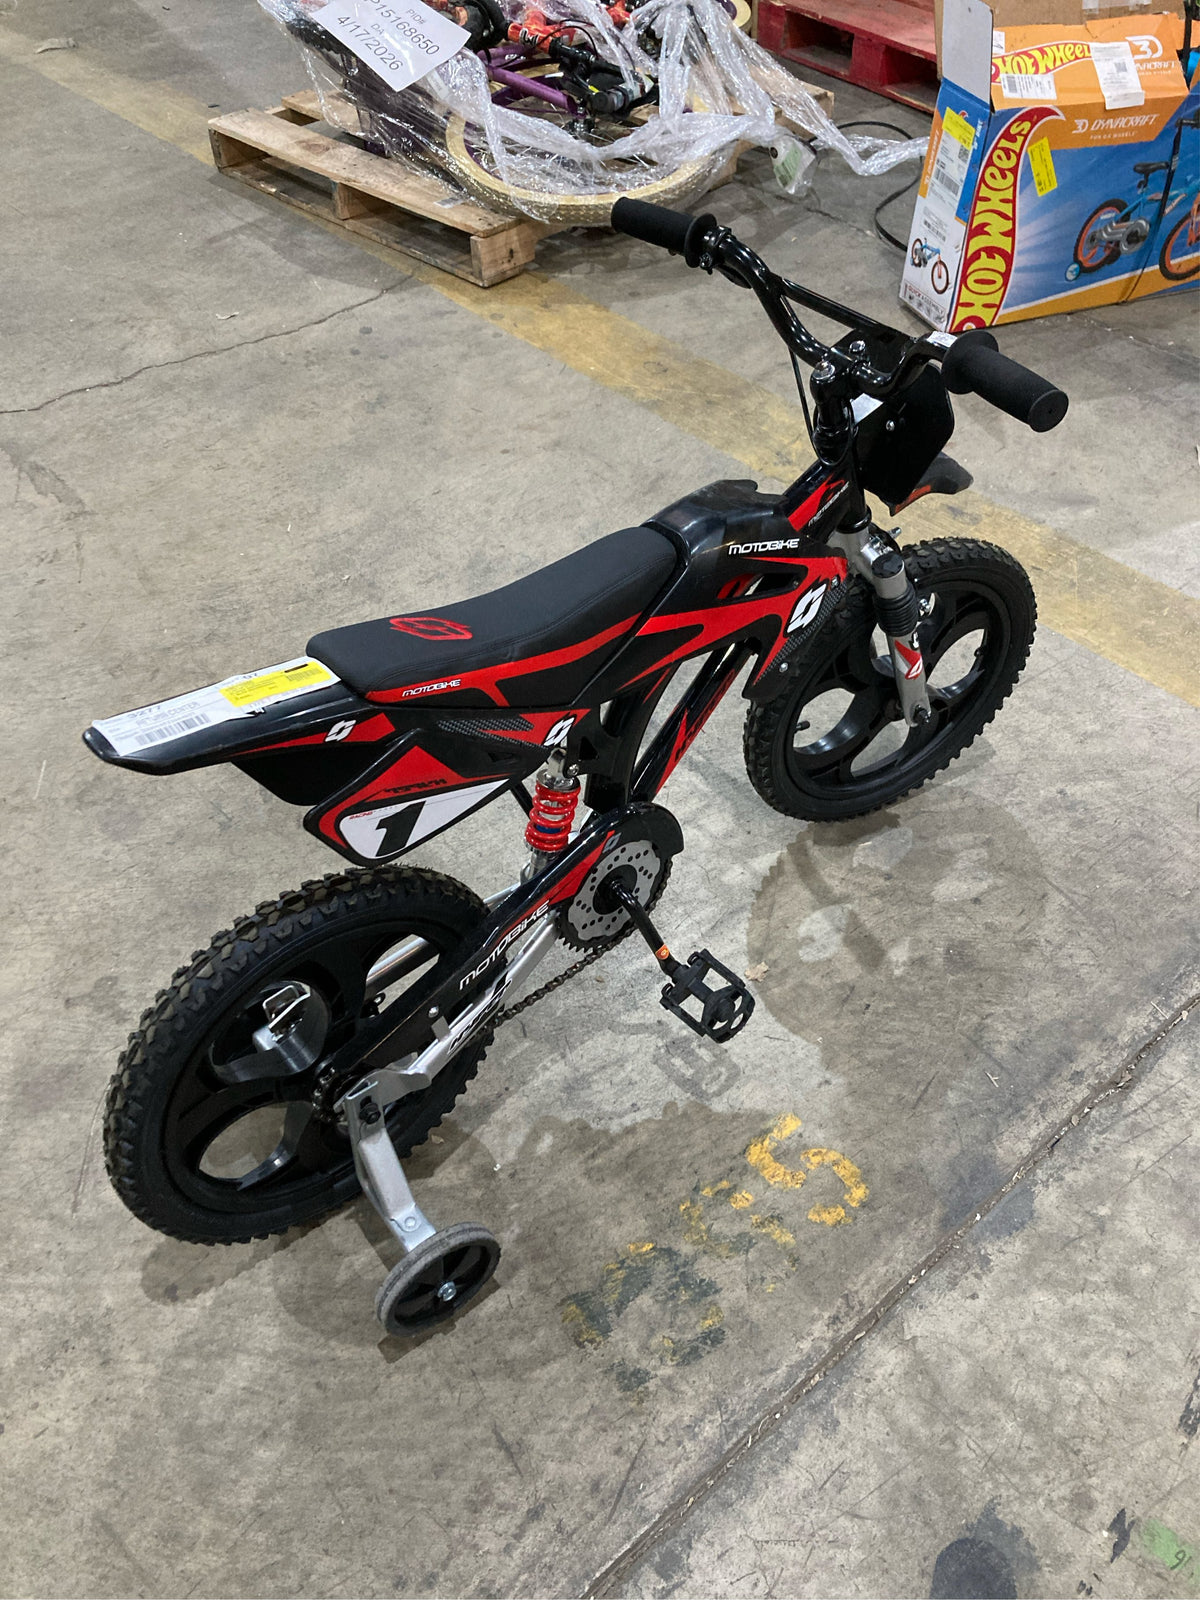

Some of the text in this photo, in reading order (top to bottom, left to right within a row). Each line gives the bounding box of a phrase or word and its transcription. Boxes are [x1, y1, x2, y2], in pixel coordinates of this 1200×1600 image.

[406, 8, 426, 25] PID#
[337, 15, 404, 71] 4/17/2026
[996, 49, 1038, 82] HOT
[1035, 43, 1091, 74] WHeeL
[1135, 60, 1176, 71] NACRAFT
[1090, 113, 1161, 131] DYNACRAFT
[954, 250, 1007, 328] HOT
[375, 800, 427, 857] 1
